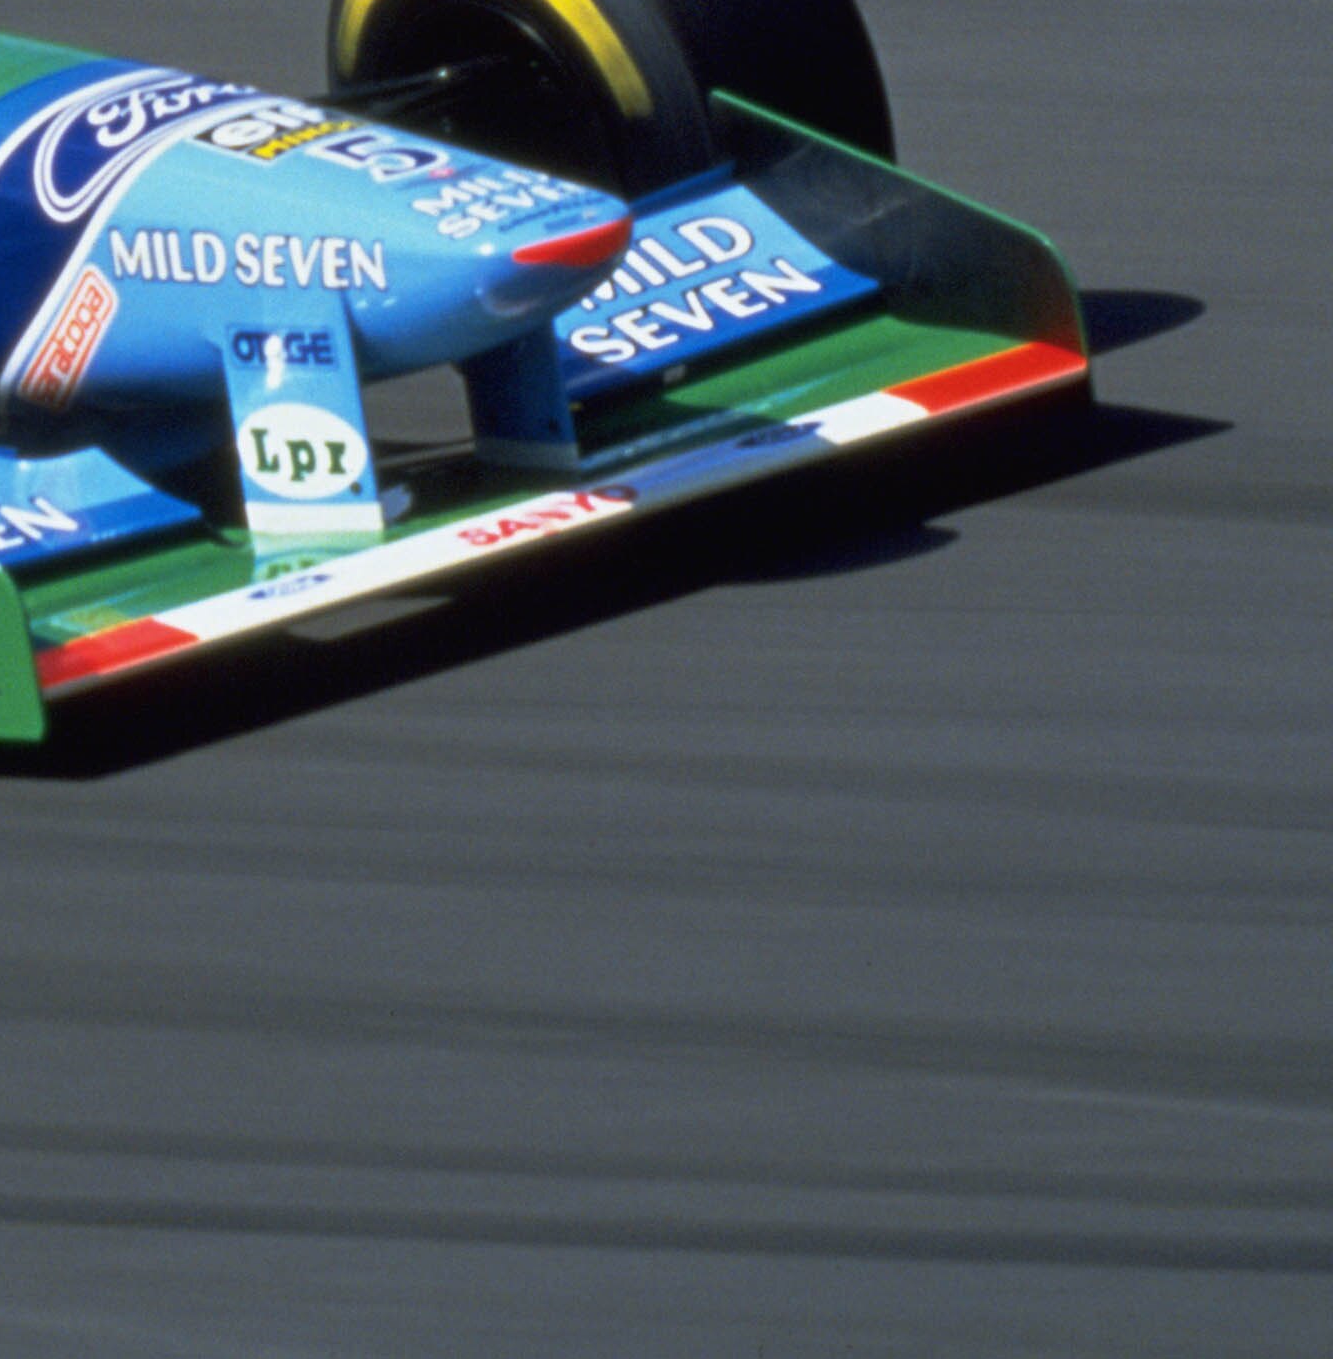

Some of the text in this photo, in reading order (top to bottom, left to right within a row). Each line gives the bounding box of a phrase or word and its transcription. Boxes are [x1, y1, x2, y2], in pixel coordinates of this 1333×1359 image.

[305, 128, 449, 184] 5
[109, 229, 388, 291] MILD SEVEN
[570, 258, 823, 364] SEVEN
[250, 427, 347, 482] Lpr
[456, 484, 637, 547] SANYO
